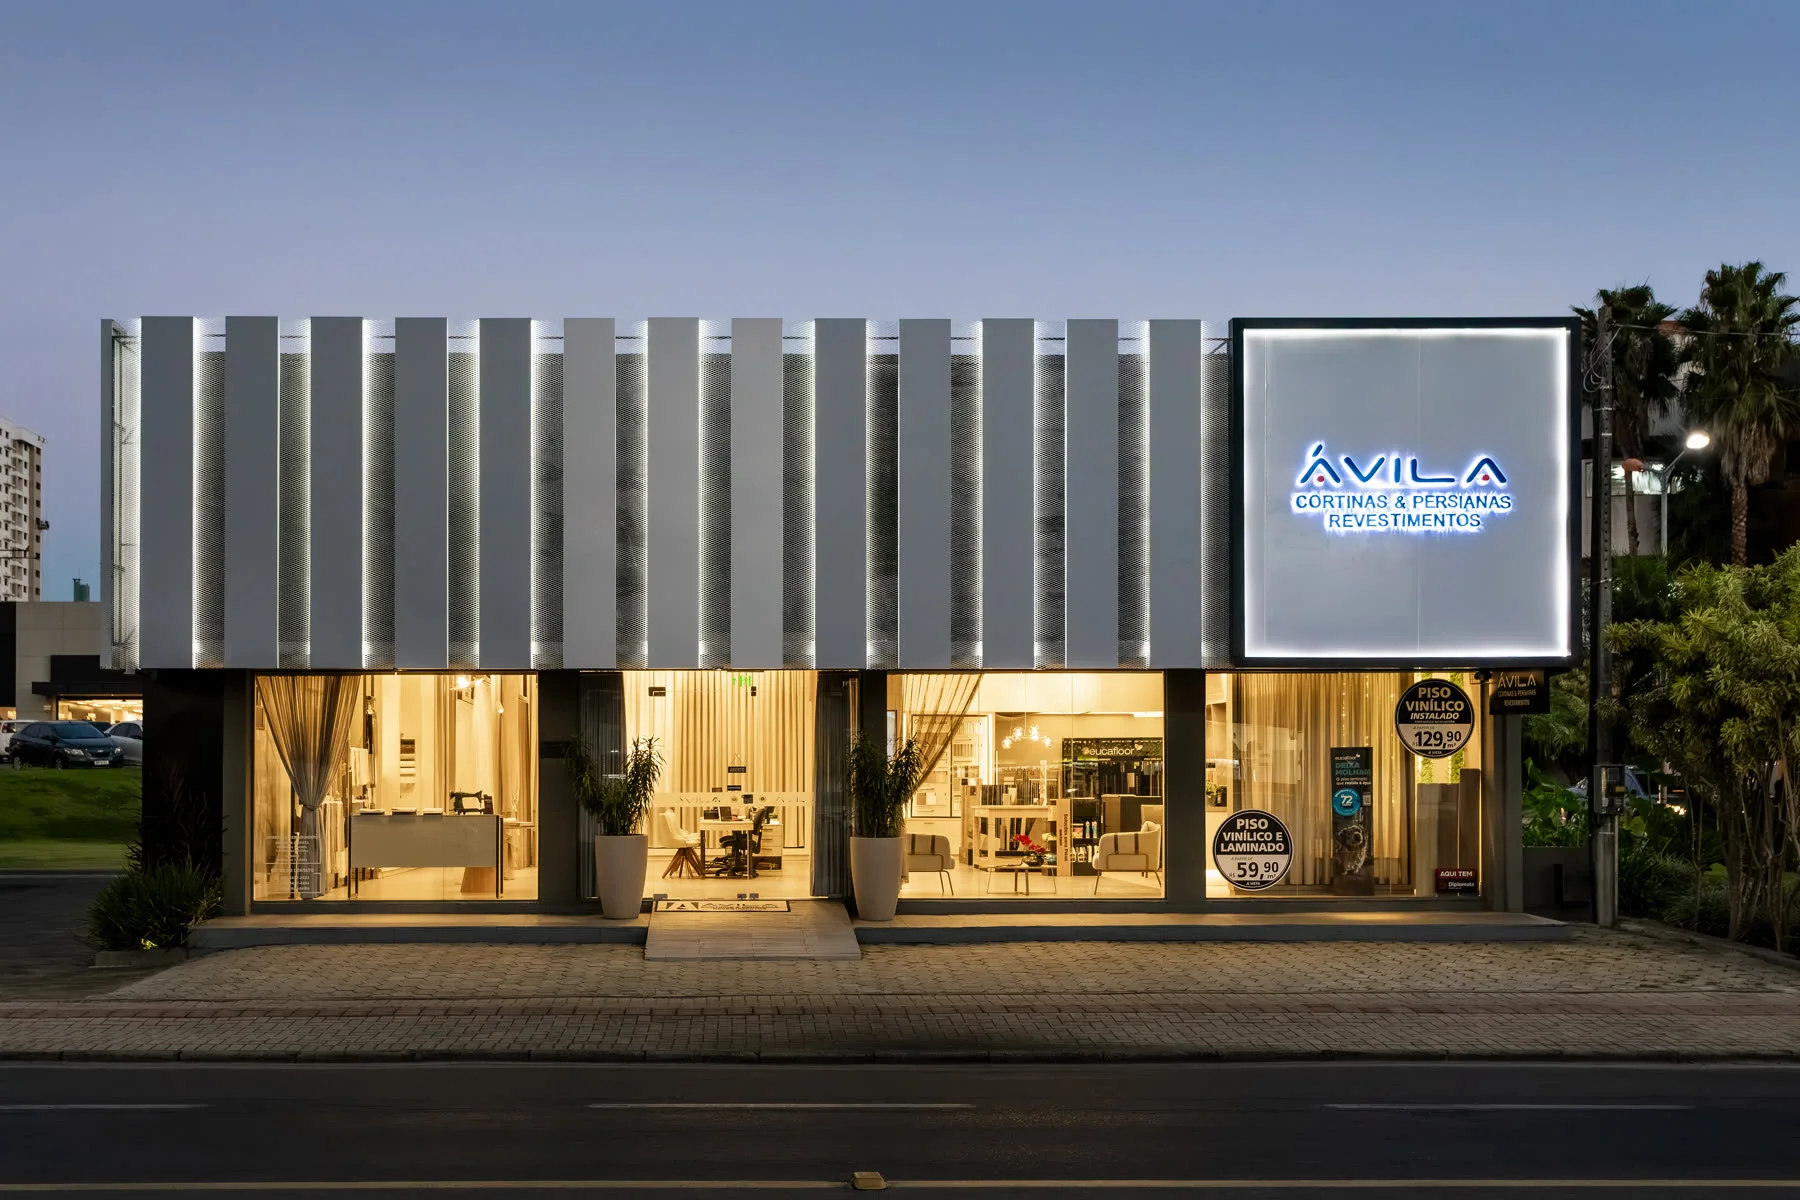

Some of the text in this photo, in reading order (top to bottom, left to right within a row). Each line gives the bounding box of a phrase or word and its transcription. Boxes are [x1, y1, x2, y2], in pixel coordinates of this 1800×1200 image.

[1300, 443, 1507, 484] ÁVILA
[1296, 494, 1512, 509] CORTINAS & PERSIANAS
[1329, 513, 1481, 528] REVESTIMENTOS
[1497, 671, 1537, 688] ÁVILA
[1418, 687, 1451, 699] PISO
[1405, 699, 1465, 711] VINÍLICO
[1410, 712, 1460, 720] INSTALADO
[1089, 746, 1134, 755] eucafloor
[1341, 795, 1353, 804] 72
[1236, 818, 1269, 830] PISO
[1222, 830, 1283, 841] VINÍLICO E
[1220, 842, 1285, 852] LAMINADO
